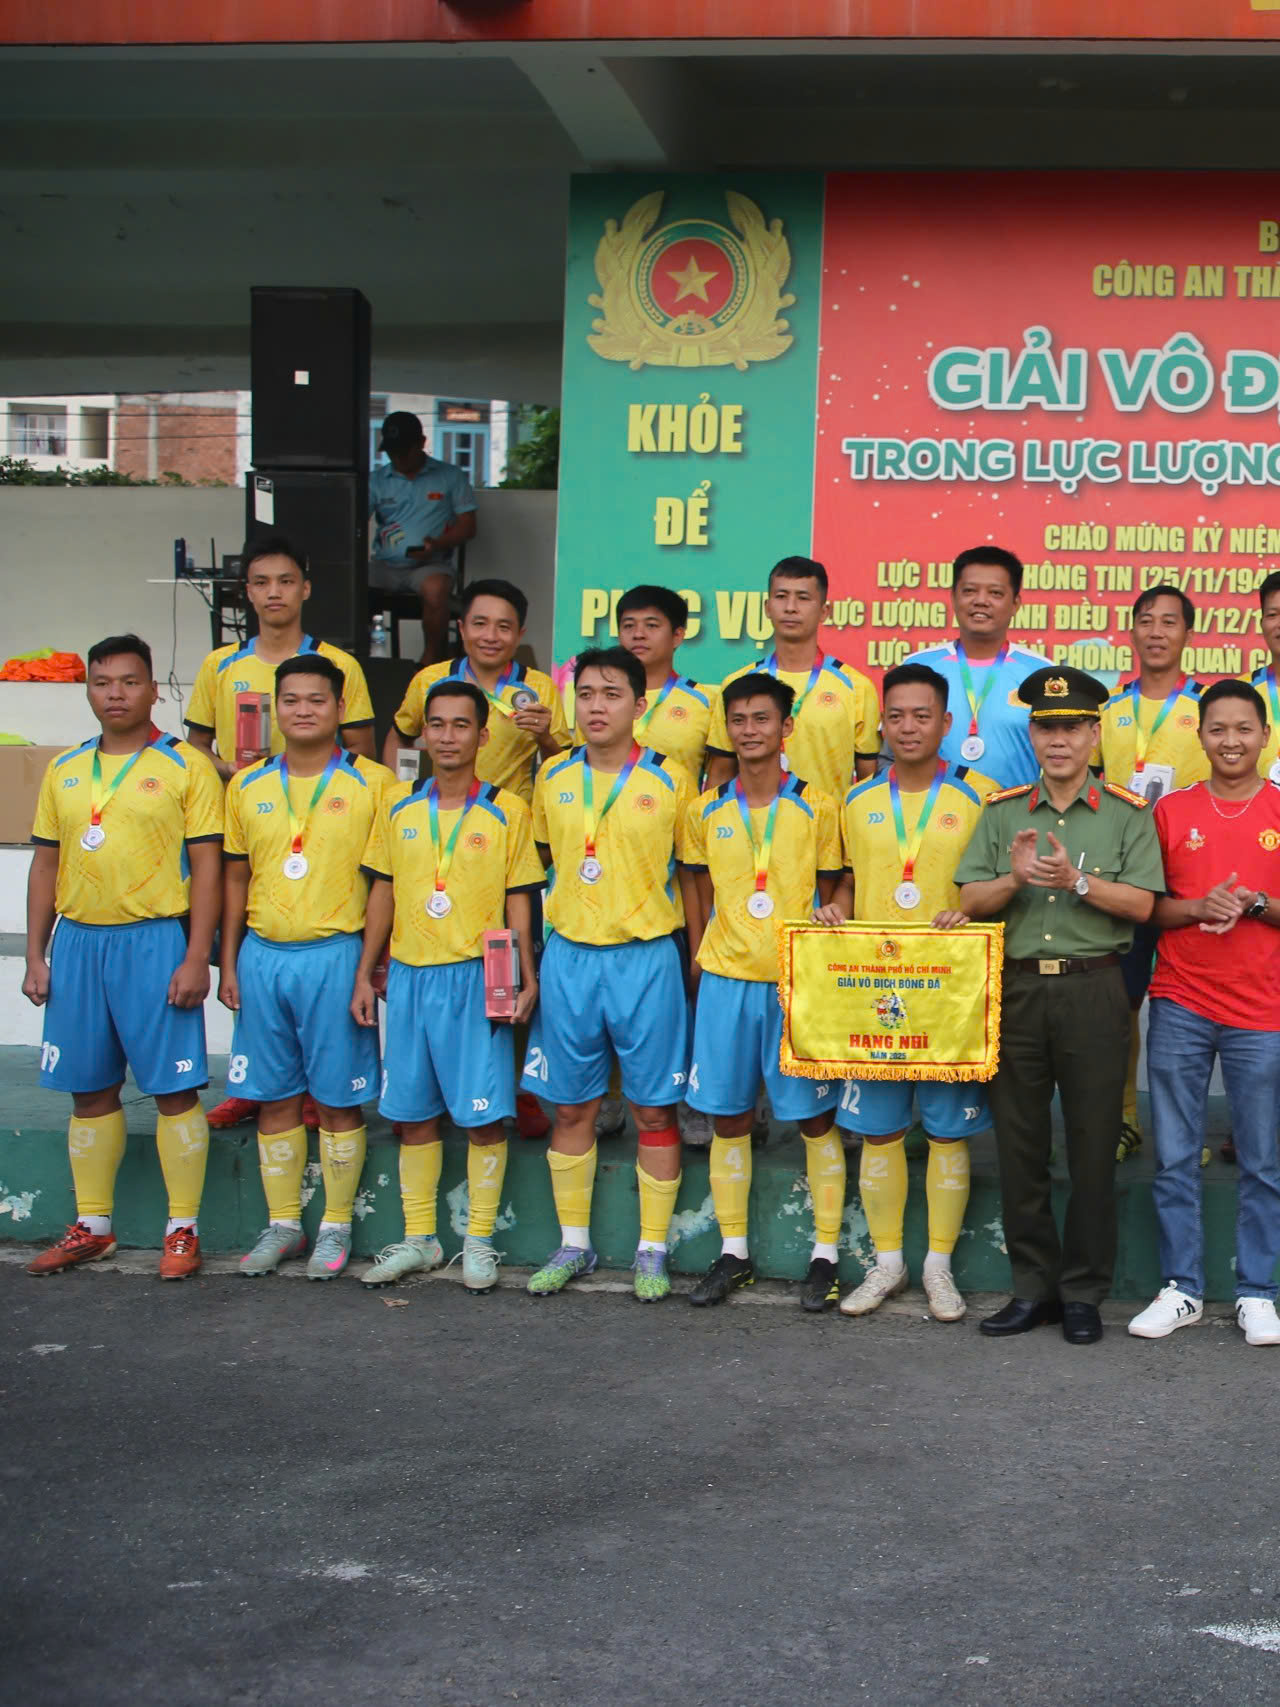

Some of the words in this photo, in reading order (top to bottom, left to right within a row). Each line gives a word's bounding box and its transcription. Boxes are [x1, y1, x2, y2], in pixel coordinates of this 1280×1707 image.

[1092, 259, 1175, 297] CÔNG
[1184, 265, 1224, 298] AN
[927, 325, 1087, 413] GIẢI
[1100, 330, 1213, 414] VÔ
[627, 392, 744, 454] KHỎE
[842, 436, 1014, 482] TRONG
[1023, 438, 1121, 494] LỰC
[653, 479, 713, 546] ĐỂ
[1044, 521, 1109, 552] CHÀO
[1115, 521, 1185, 553] MỪNG
[1192, 521, 1224, 554] KỶ
[877, 558, 921, 593] LỰC
[1022, 559, 1087, 592] HÔNG
[1094, 565, 1133, 592] TIN
[871, 598, 946, 633] LƯỢNG
[1054, 596, 1110, 631] ĐIỀU
[1180, 646, 1242, 676] QUAN
[40, 1041, 61, 1073] 19
[849, 1034, 893, 1051] HẠNG
[899, 1032, 928, 1050] NHÌ
